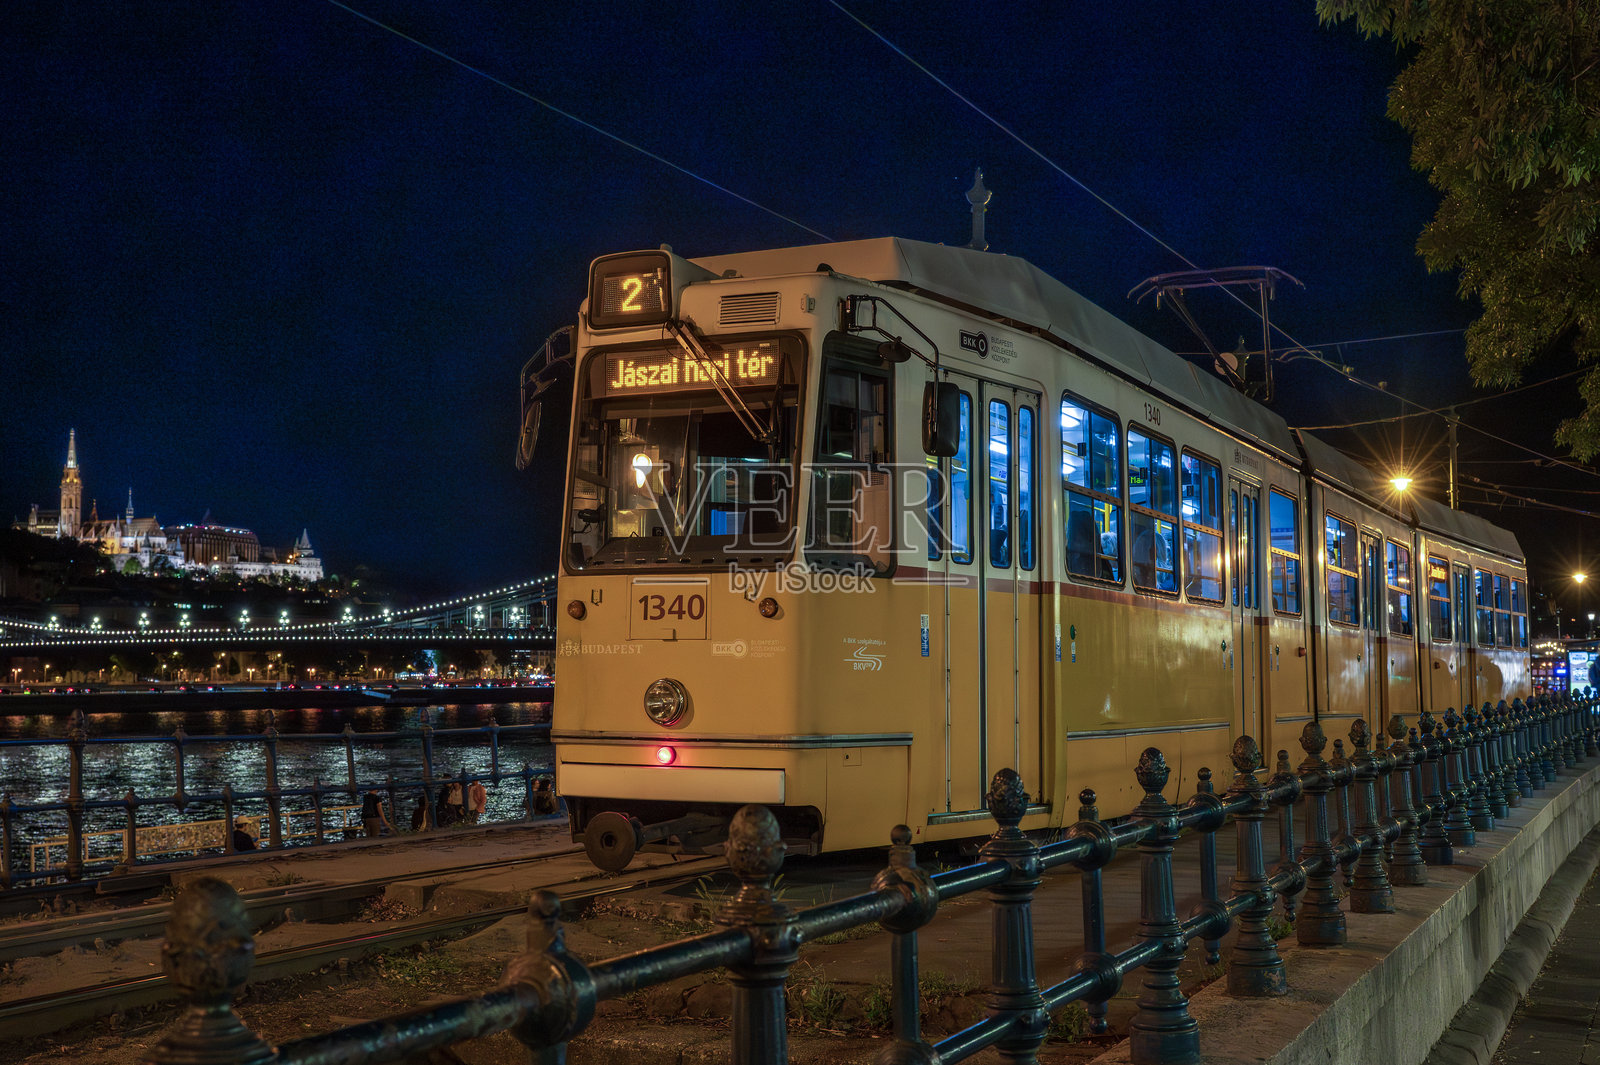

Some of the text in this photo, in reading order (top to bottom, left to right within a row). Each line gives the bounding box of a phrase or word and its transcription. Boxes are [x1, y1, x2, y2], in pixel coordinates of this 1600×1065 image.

[621, 277, 643, 312] 2
[962, 336, 978, 348] BKK
[611, 356, 678, 388] Jászai
[736, 350, 774, 379] tér
[1143, 401, 1161, 426] 1340
[638, 594, 705, 621] 1340
[581, 644, 643, 655] BUDAPEST
